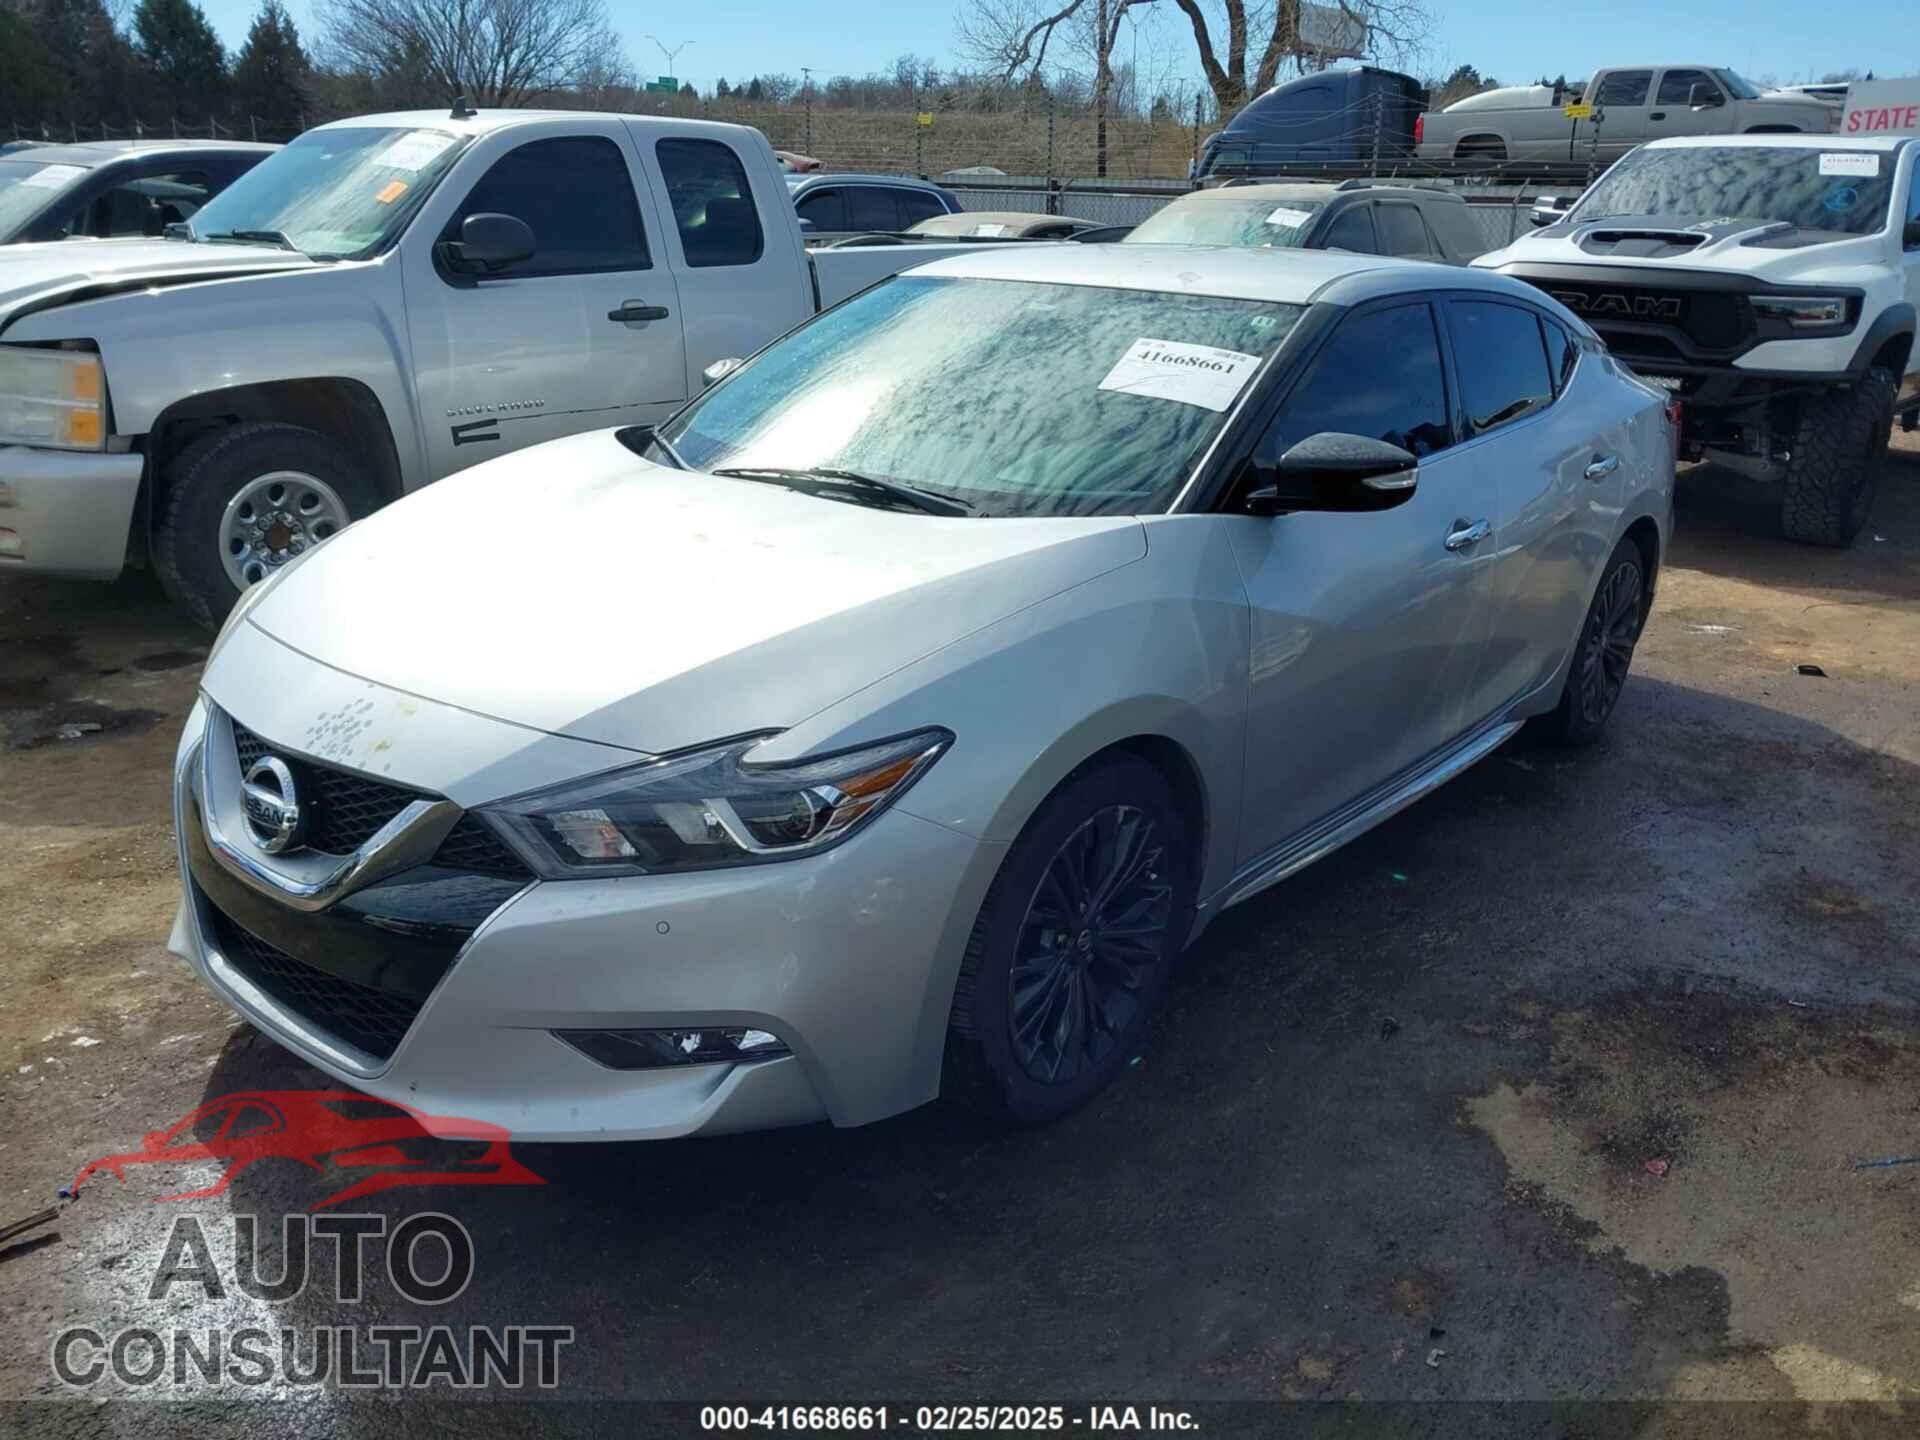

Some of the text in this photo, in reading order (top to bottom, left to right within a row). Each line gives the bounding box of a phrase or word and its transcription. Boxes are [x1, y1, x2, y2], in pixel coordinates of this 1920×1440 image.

[1847, 105, 1919, 133] STATE
[1551, 290, 1681, 317] RAM
[1137, 350, 1237, 375] 41668661
